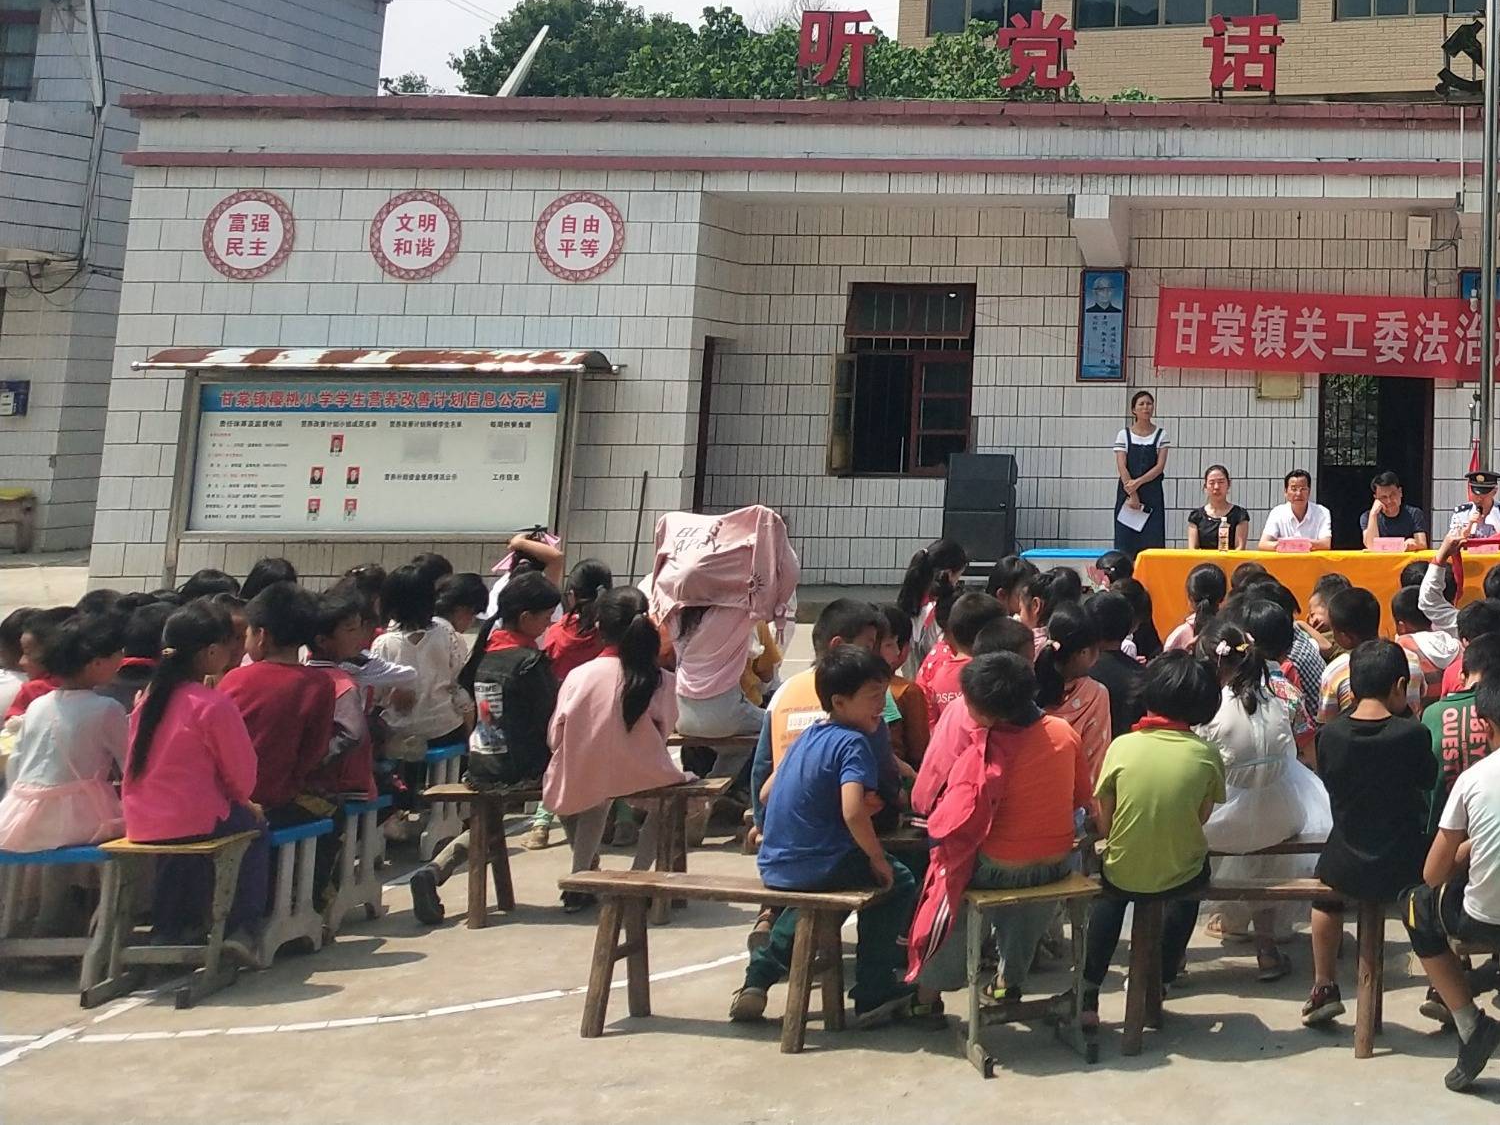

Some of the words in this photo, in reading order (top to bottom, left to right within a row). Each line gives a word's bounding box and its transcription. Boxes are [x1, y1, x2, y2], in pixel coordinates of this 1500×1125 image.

[798, 10, 1284, 91] 听党话
[228, 212, 270, 234] 富强
[395, 212, 437, 234] 文明
[560, 214, 600, 234] 自由
[225, 237, 267, 258] 民主
[393, 237, 437, 258] 和谐
[558, 238, 599, 259] 平等
